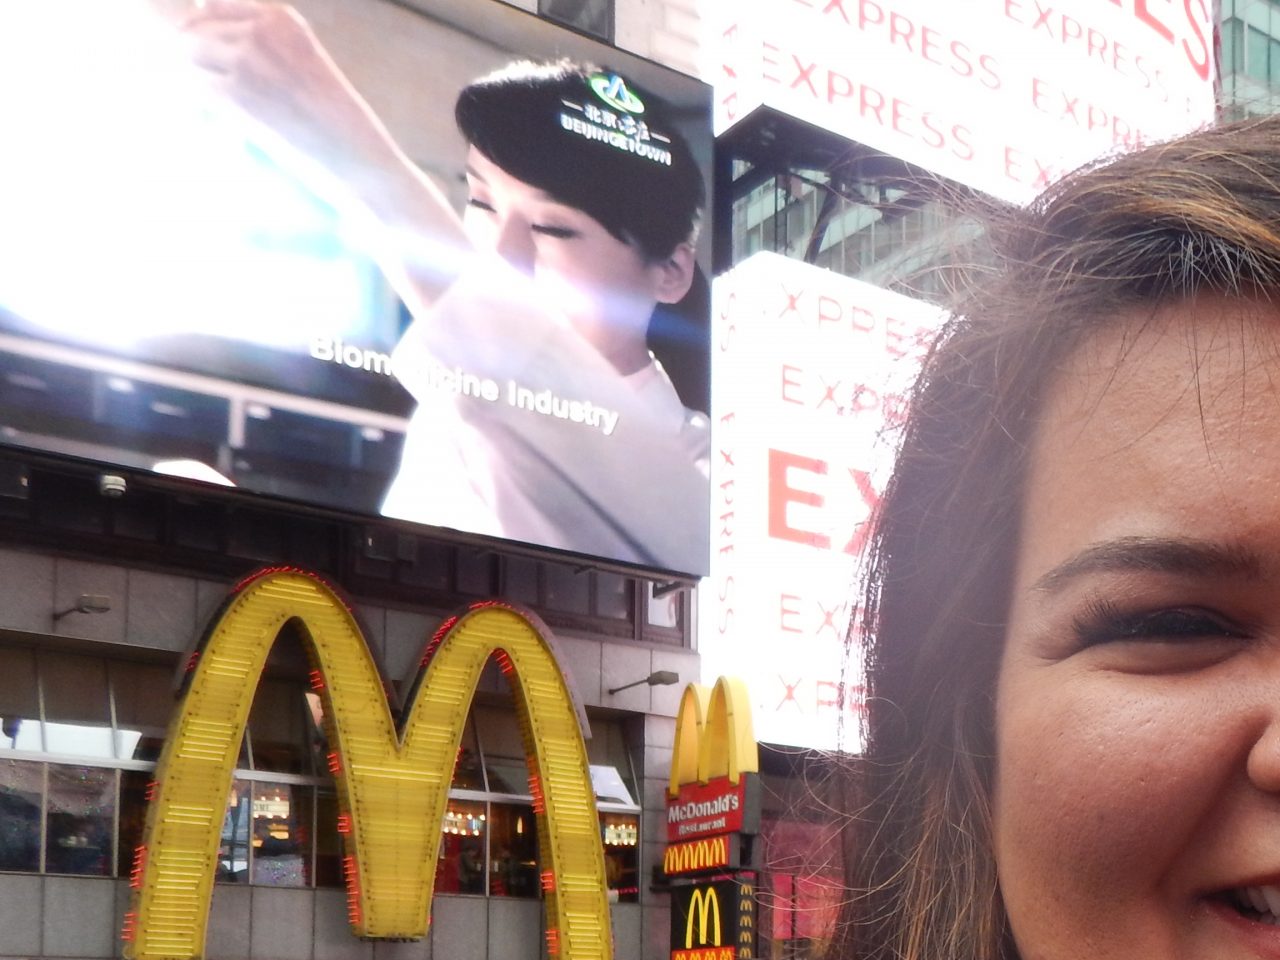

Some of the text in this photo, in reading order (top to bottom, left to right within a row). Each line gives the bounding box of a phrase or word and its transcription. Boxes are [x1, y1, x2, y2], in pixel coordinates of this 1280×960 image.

[790, 0, 1001, 90] XPRESS
[762, 41, 975, 161] EXPRESS
[508, 379, 619, 436] Industry
[667, 793, 740, 824] McDonald's
